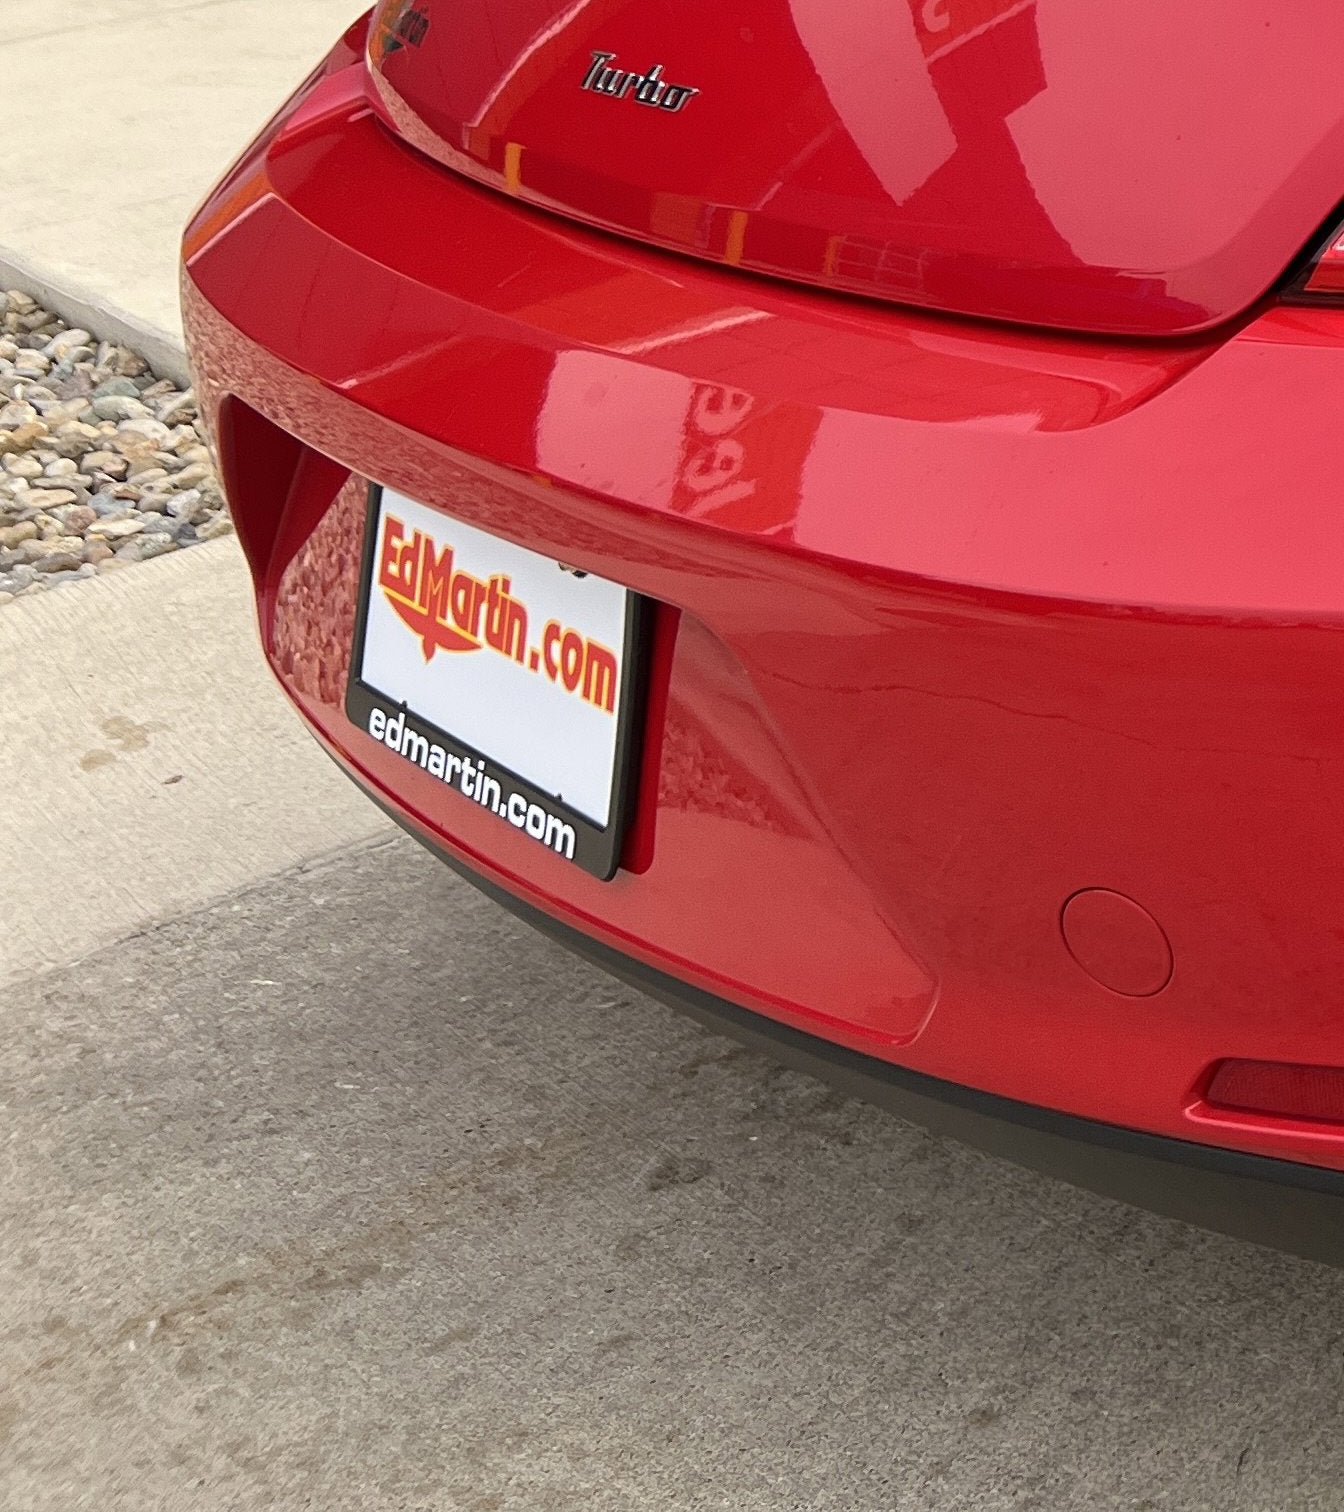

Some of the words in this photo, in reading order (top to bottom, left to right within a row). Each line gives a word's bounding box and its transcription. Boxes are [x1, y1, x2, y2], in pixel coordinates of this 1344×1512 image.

[580, 50, 700, 112] Turbo
[379, 512, 618, 715] EdMartin.com
[367, 705, 577, 860] edmartin.com
